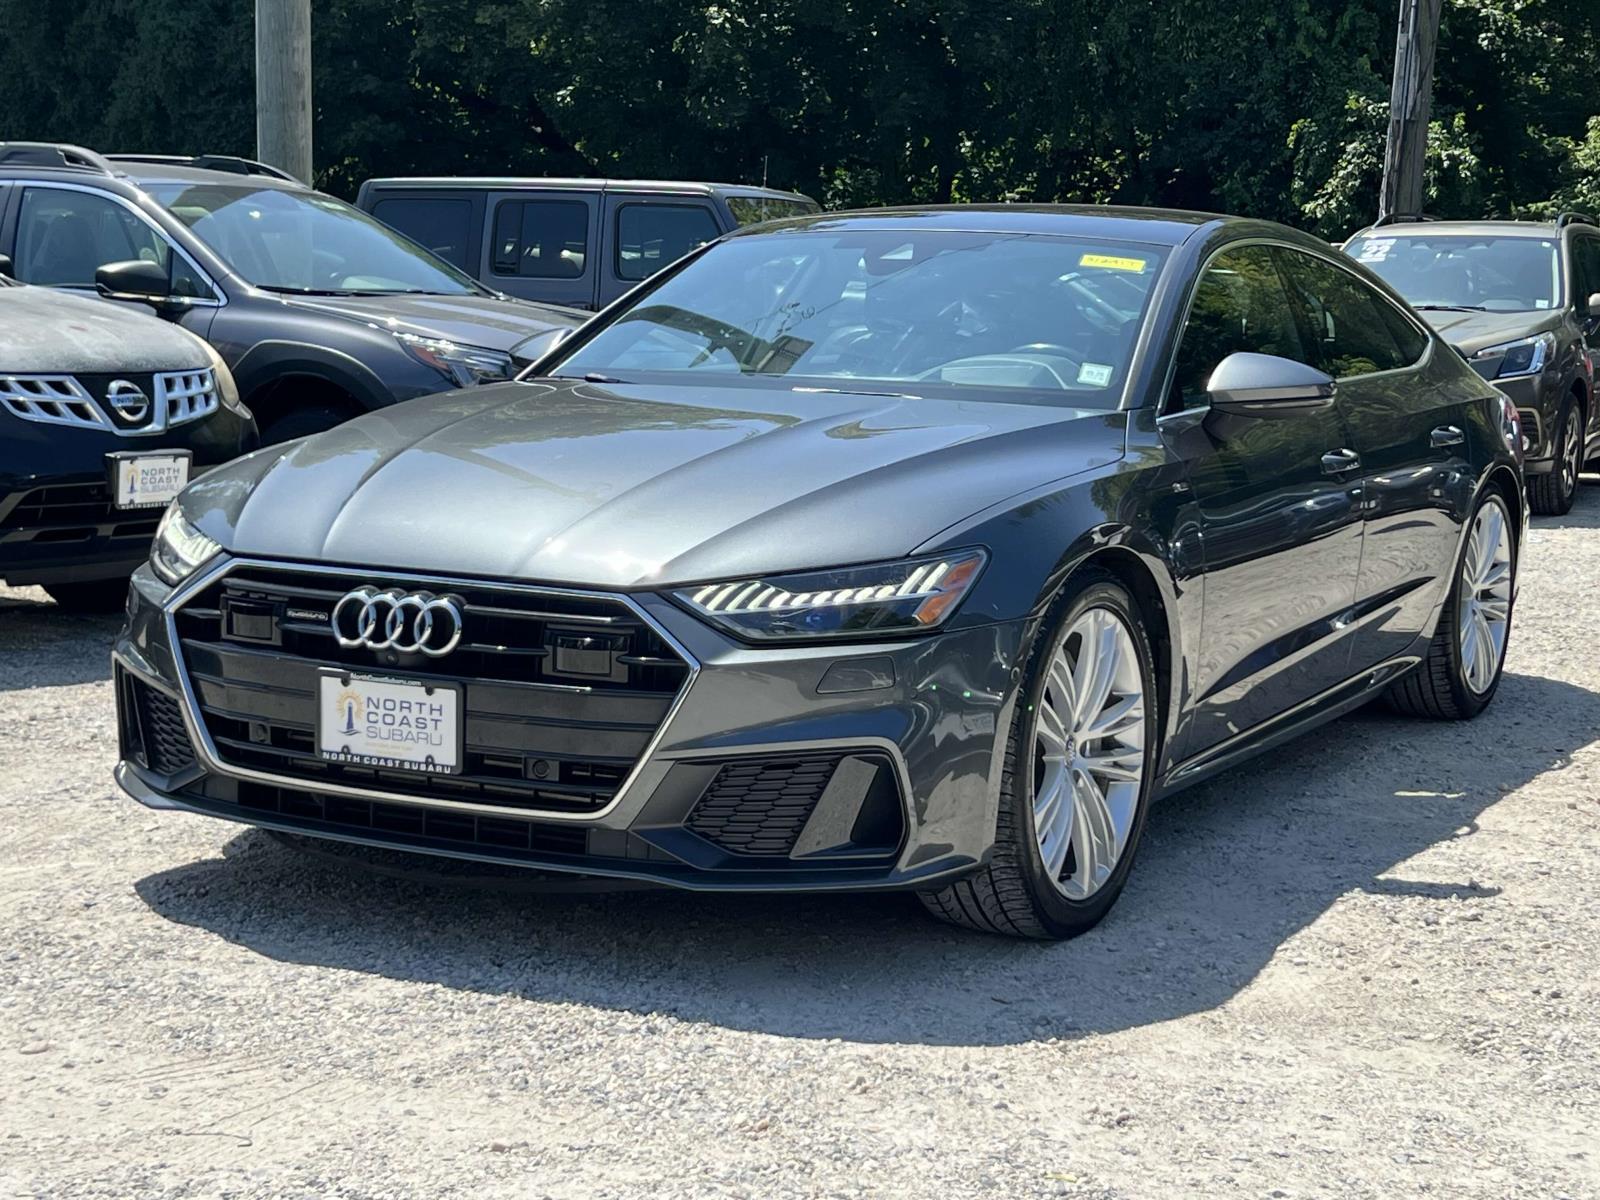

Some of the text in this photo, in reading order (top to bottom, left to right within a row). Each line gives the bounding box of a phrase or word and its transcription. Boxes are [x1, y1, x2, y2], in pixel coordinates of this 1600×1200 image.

[141, 467, 180, 477] NORTH
[141, 475, 179, 485] COAST
[366, 696, 442, 716] NORTH
[366, 711, 442, 731] COAST
[366, 725, 442, 746] SUBARU
[322, 751, 451, 773] NORTH COAST SUBARU
